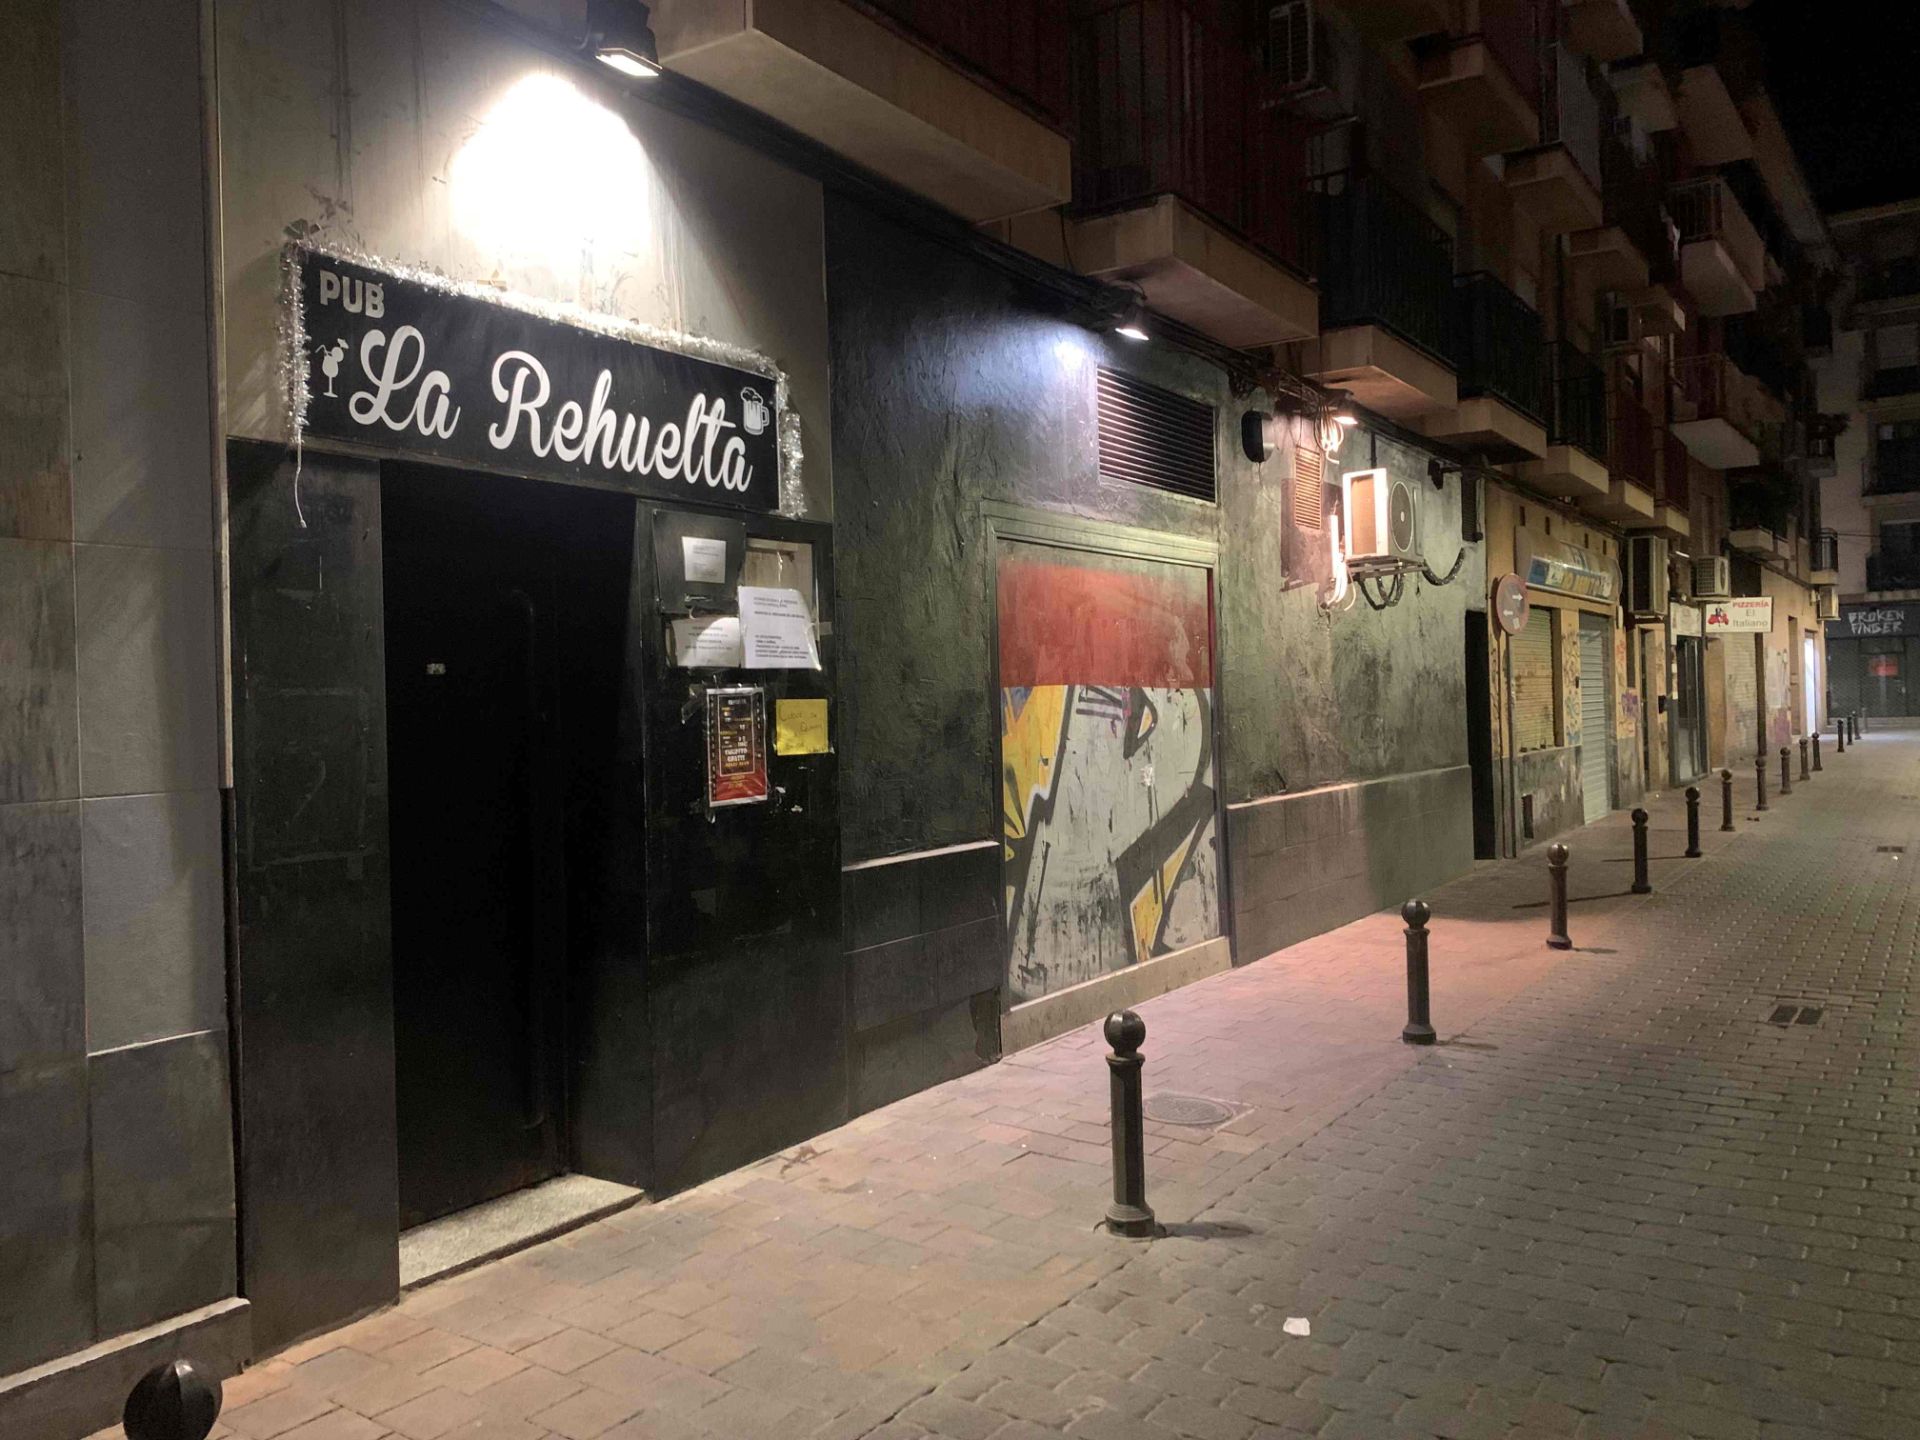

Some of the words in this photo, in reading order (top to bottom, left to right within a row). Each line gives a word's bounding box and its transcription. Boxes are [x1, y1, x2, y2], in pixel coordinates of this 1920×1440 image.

[320, 270, 385, 318] PUB
[349, 325, 461, 439] La
[489, 350, 753, 492] Rehuelta
[1733, 619, 1769, 627] Italiano
[1848, 609, 1904, 623] BROKEN
[1851, 621, 1902, 634] FINGER
